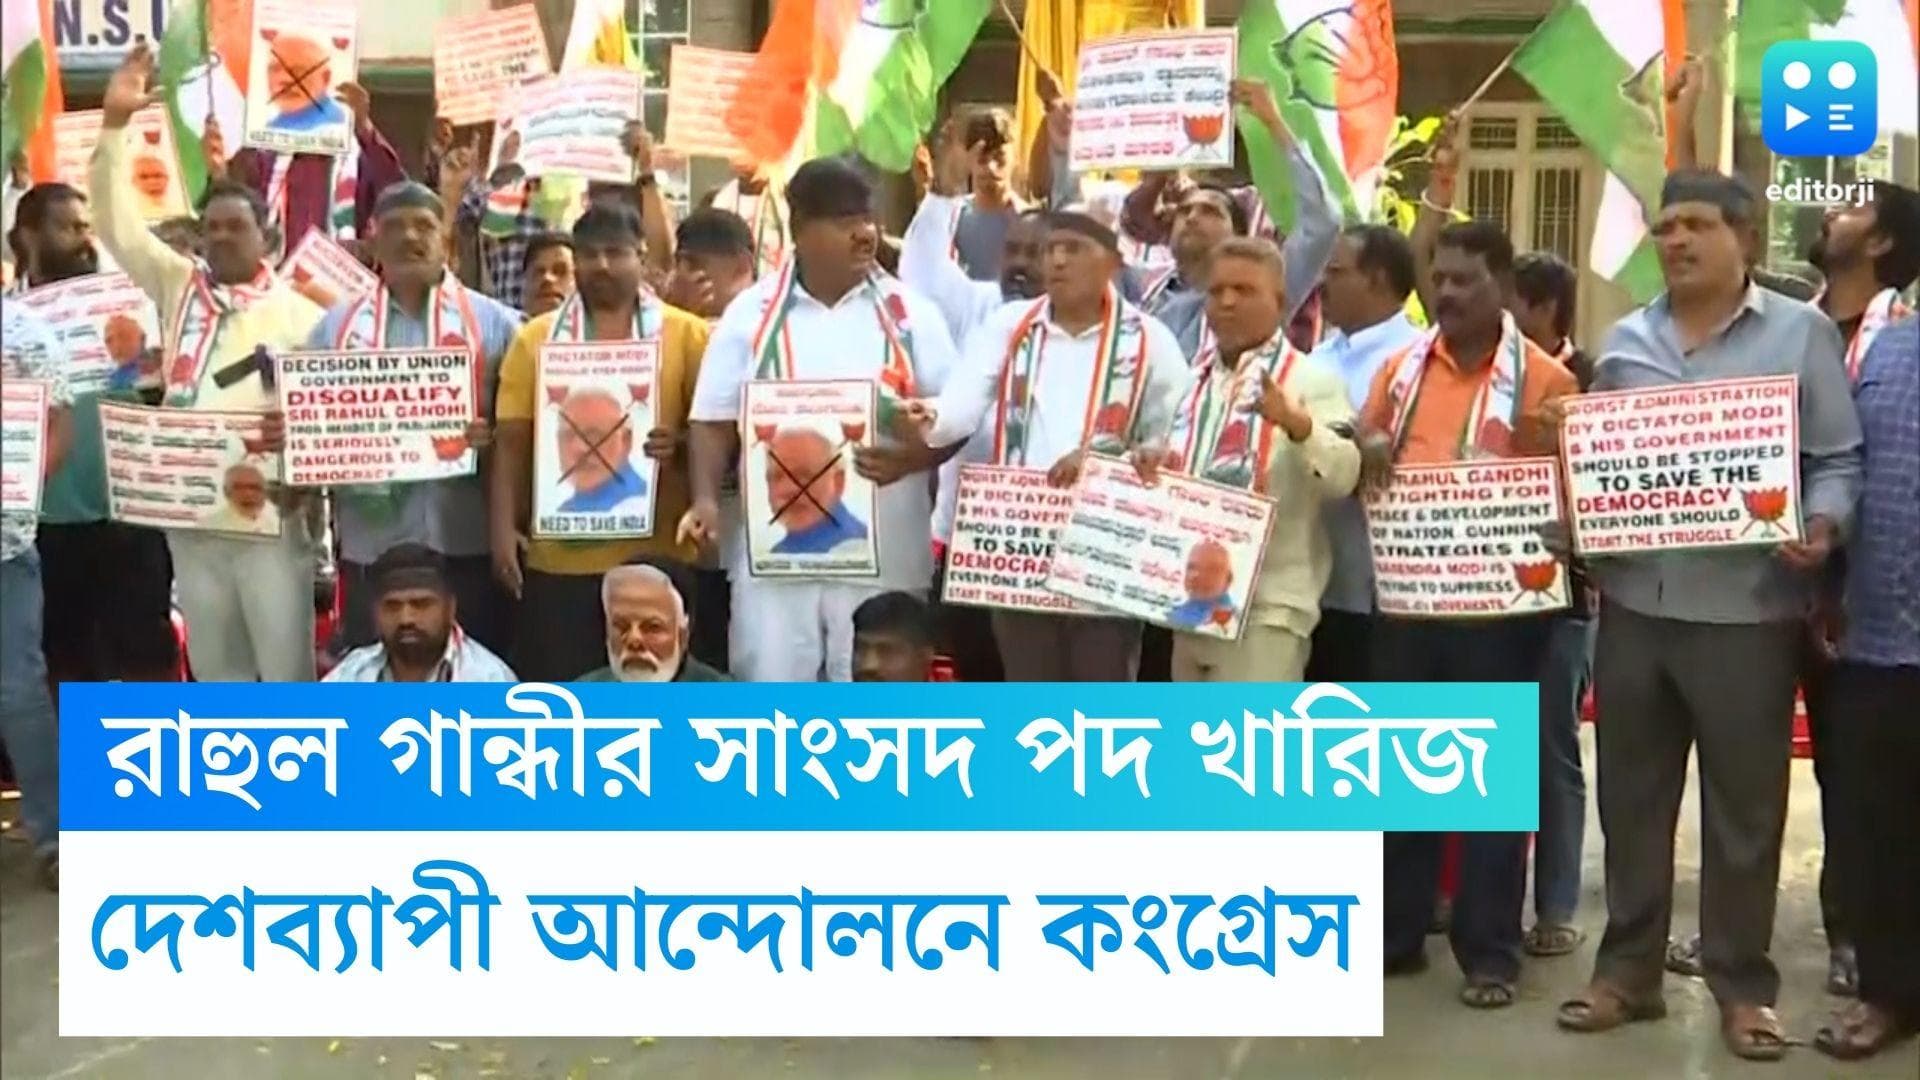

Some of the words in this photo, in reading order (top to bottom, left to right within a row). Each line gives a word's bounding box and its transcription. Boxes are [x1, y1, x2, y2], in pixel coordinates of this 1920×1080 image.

[283, 358, 371, 373] DECISION
[377, 357, 399, 370] BY
[407, 355, 466, 369] UNION
[300, 373, 420, 387] GOVERNMENT
[428, 372, 450, 383] TO
[287, 386, 462, 406] DISQUALIFY
[1568, 399, 1627, 415] WORST
[1633, 387, 1790, 410] ADMINISTRATION
[288, 407, 318, 422] SRI
[325, 406, 387, 421] RAHUL
[395, 404, 467, 418] GANDHI
[1568, 423, 1594, 436] BY
[1602, 411, 1713, 433] DICTATOR
[1722, 405, 1784, 422] MODI
[291, 438, 306, 450] IS
[313, 436, 401, 450] SERIOUSLY
[1570, 443, 1582, 455] &
[1591, 438, 1626, 453] HIS
[1633, 425, 1788, 450] GOVERNMENT
[292, 453, 394, 467] DANGEROUS
[401, 451, 420, 463] TO
[1571, 456, 1649, 474] SHOULD
[1656, 453, 1680, 467] BE
[1688, 444, 1784, 463] STOPPED
[293, 469, 397, 483] DEMOCRACY
[960, 471, 1005, 483] WORST
[1467, 466, 1549, 484] GANDHI
[1597, 475, 1630, 493] TO
[1639, 469, 1701, 491] SAVE
[1710, 465, 1762, 485] THE
[960, 488, 979, 499] BY
[1388, 487, 1493, 503] FIGHTING
[1502, 485, 1550, 499] FOR
[1577, 488, 1732, 514] DEMOCRACY
[972, 505, 999, 518] HIS
[1431, 503, 1551, 520] DEVELOPMENT
[1580, 511, 1664, 531] EVERYONE
[1670, 508, 1741, 526] SHOULD
[540, 516, 570, 531] NEED
[574, 516, 587, 530] TO
[590, 516, 616, 531] SAVE
[956, 521, 1016, 536] SHOULD
[1020, 526, 1042, 539] BE
[1371, 528, 1388, 539] OF
[1466, 523, 1543, 538] CUNNIN
[973, 537, 997, 553] TO
[1004, 539, 1056, 557] SAVE
[1582, 534, 1623, 549] START
[1628, 532, 1652, 546] THE
[1373, 542, 1511, 558] STRATEGIES
[952, 552, 1052, 573] DEMOCRA
[950, 571, 1019, 587] EVERYONE
[1421, 581, 1437, 593] TO
[1440, 580, 1514, 594] SUPPRESS
[949, 587, 981, 598] START
[985, 590, 1007, 602] THE
